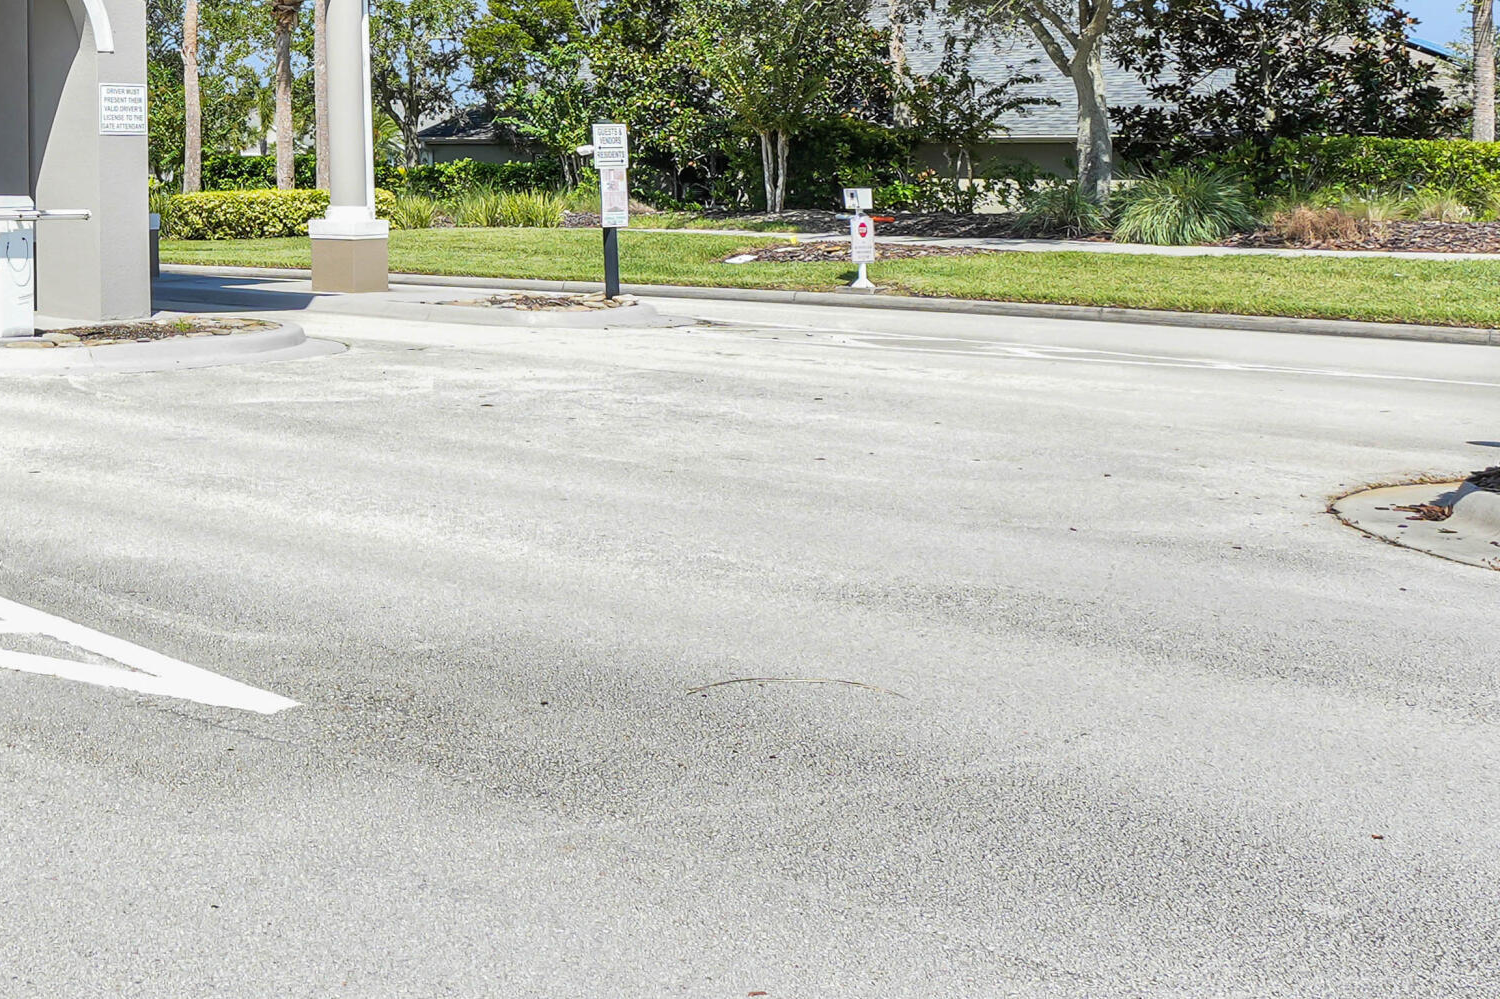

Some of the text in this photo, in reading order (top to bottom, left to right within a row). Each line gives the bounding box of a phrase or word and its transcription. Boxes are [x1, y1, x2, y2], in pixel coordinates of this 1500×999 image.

[597, 128, 617, 136] GUESTS
[600, 136, 622, 145] VENDORS
[597, 150, 625, 158] RESIDENTS
